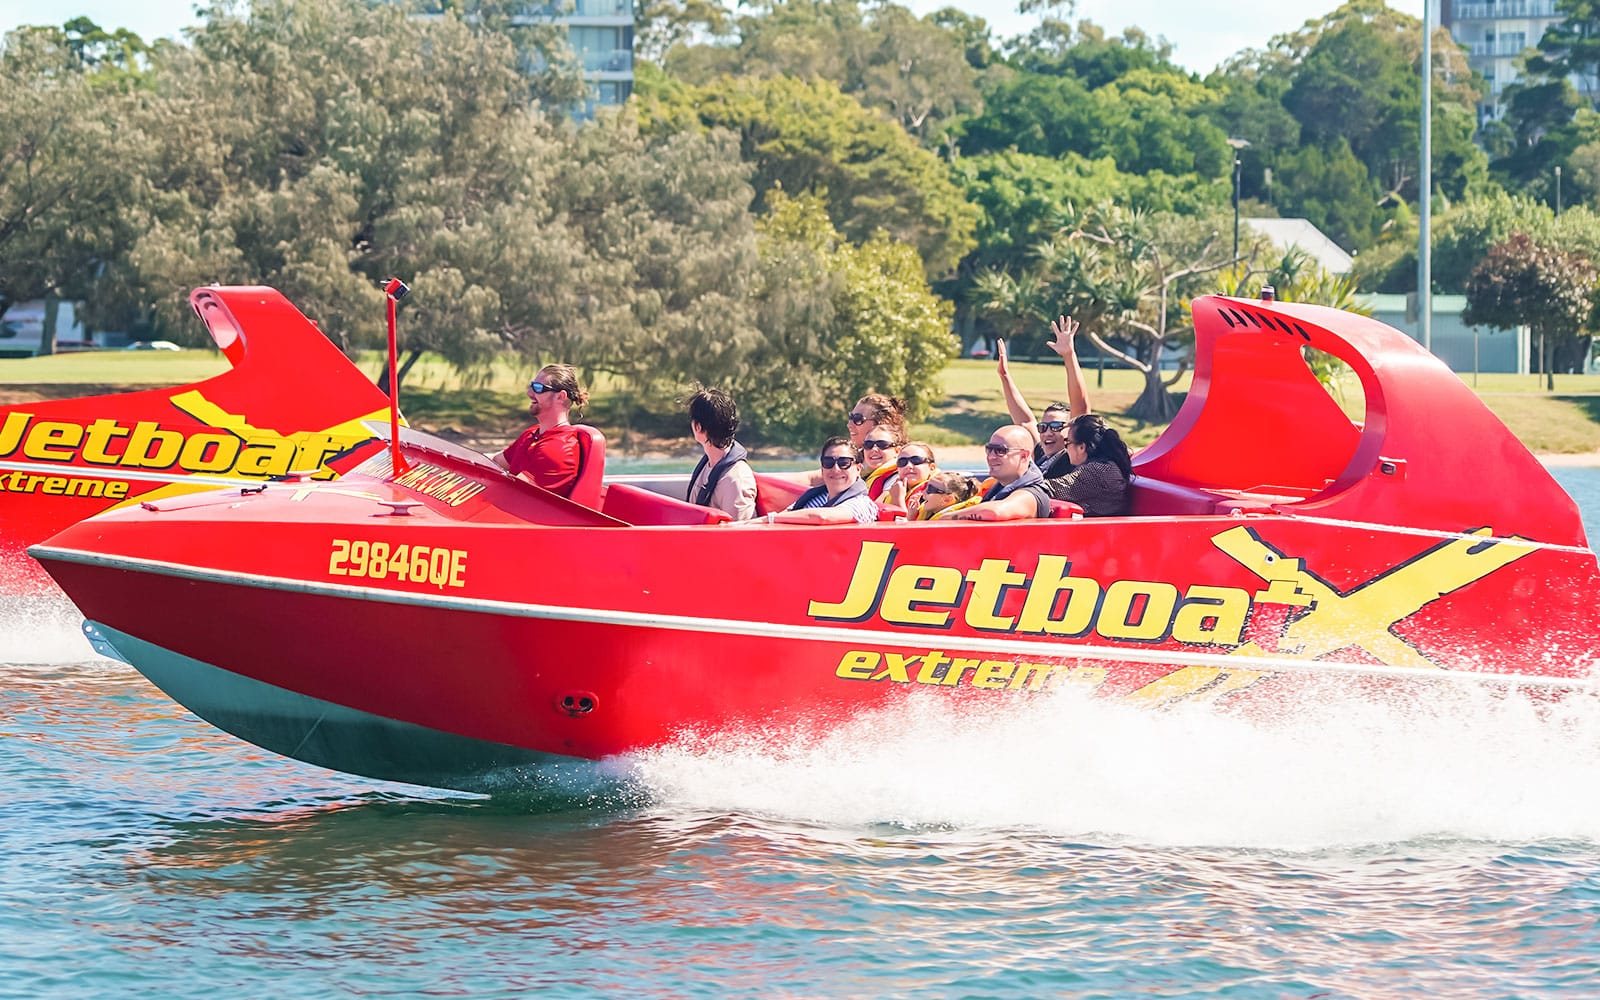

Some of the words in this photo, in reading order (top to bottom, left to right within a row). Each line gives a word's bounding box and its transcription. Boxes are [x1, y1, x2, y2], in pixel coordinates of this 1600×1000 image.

[0, 411, 345, 481] Jetboat
[328, 538, 468, 590] 29846QE
[807, 540, 1317, 654] Jetboat
